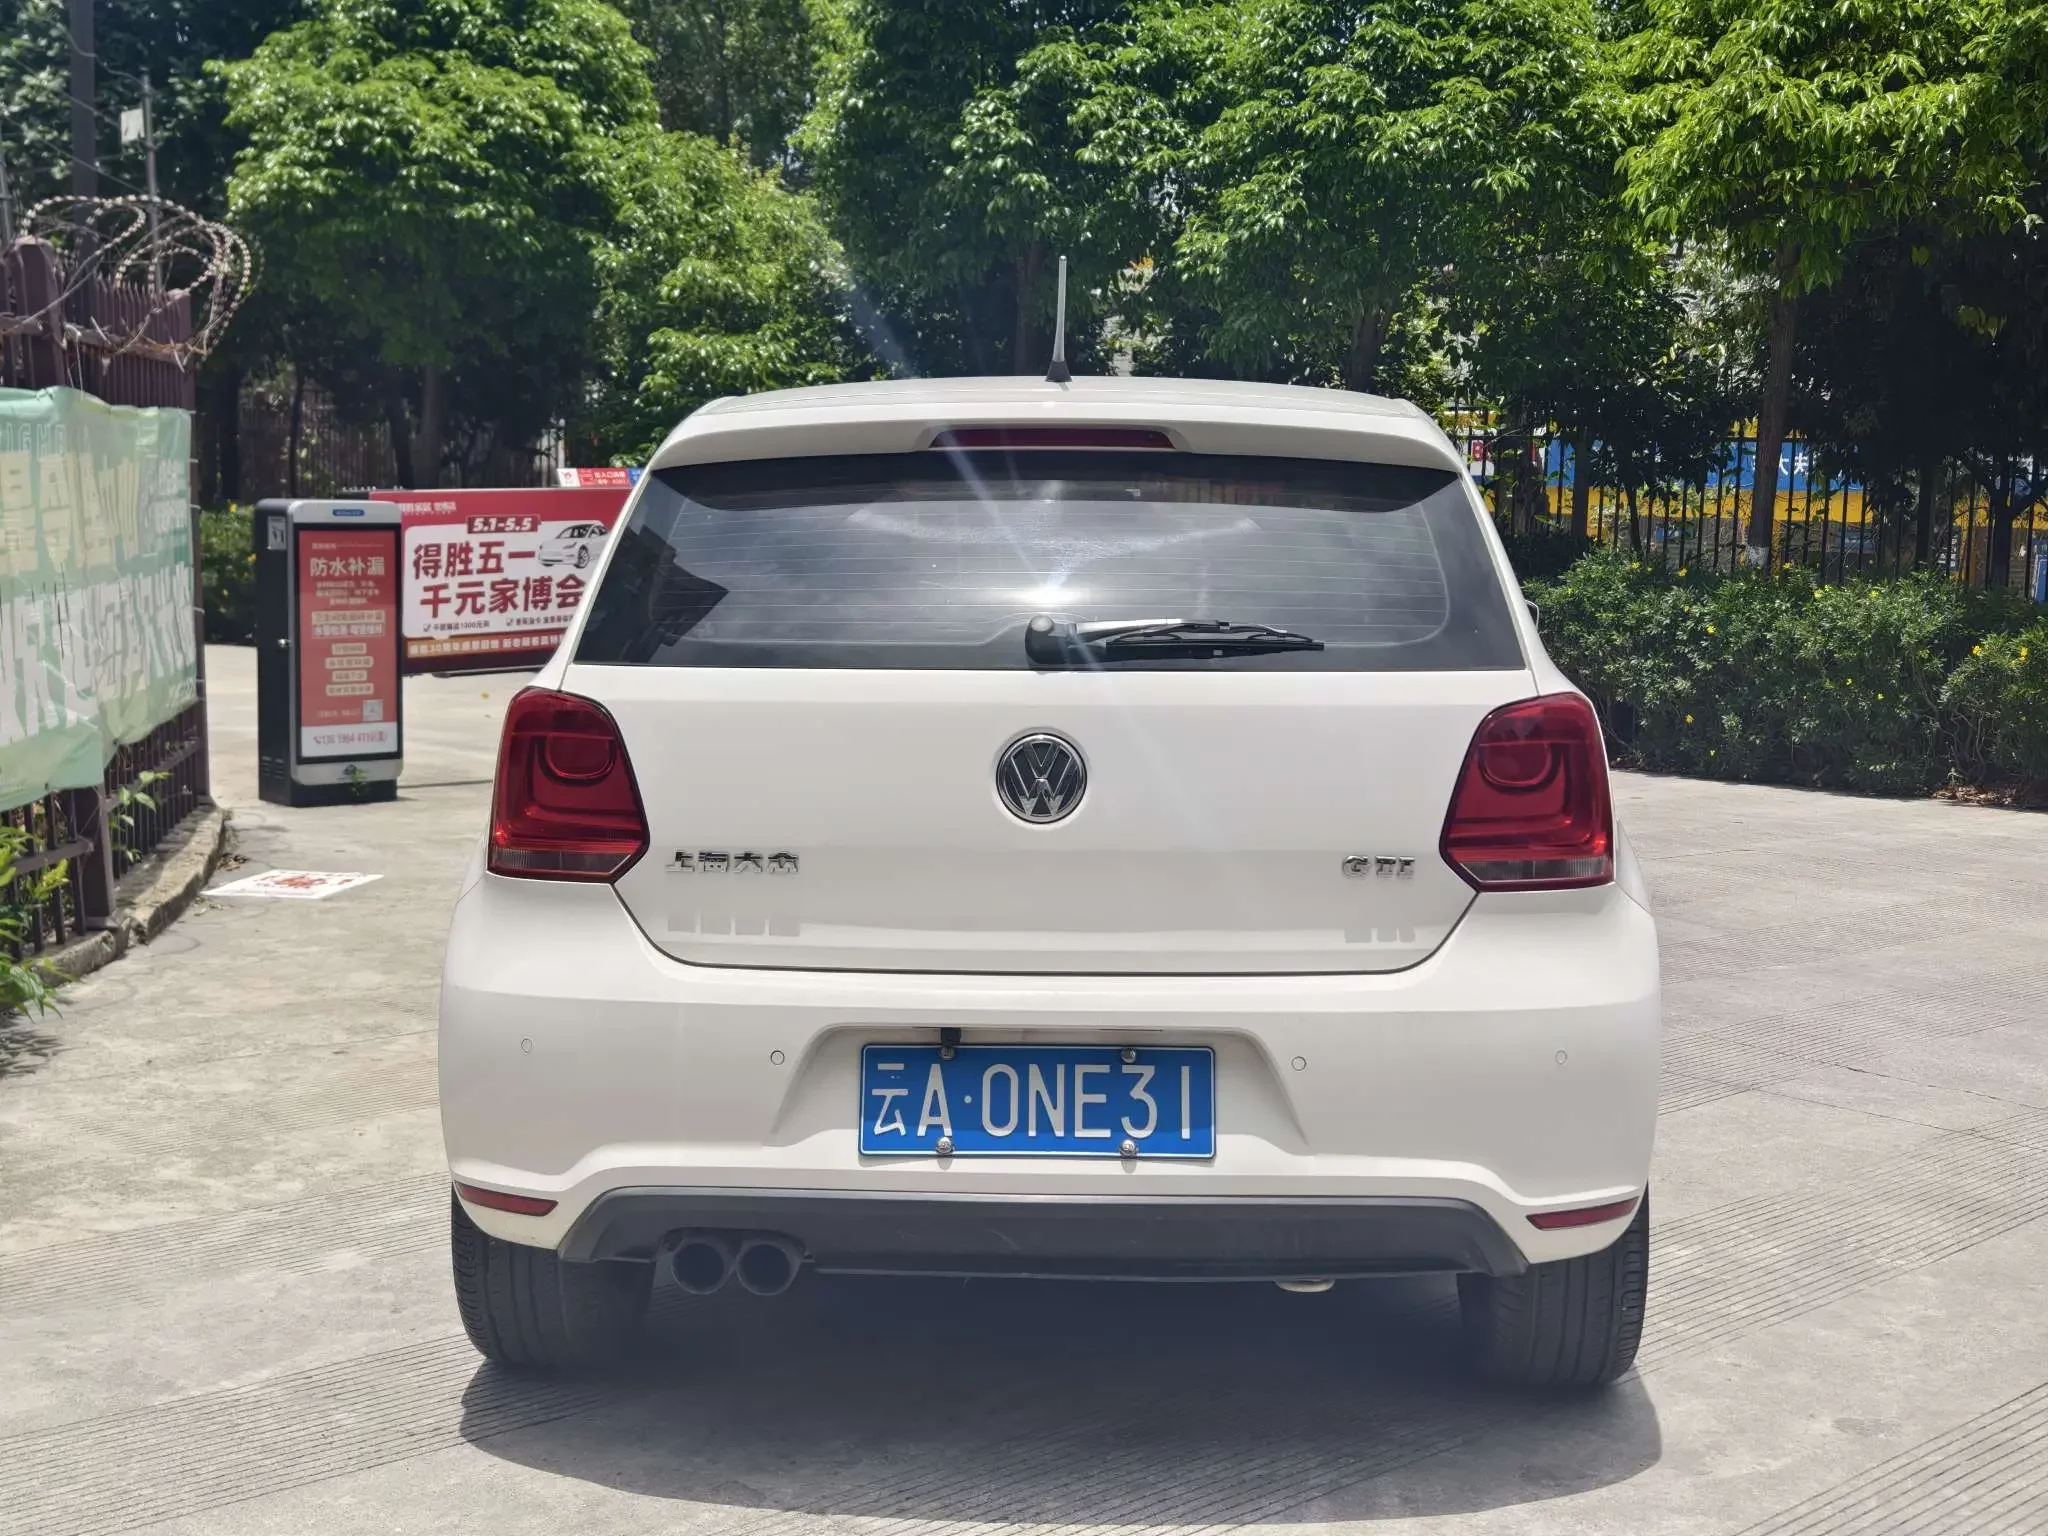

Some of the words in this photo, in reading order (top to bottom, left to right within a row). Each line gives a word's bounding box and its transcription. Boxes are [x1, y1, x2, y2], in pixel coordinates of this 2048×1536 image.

[472, 517, 533, 532] 5.1-5.5
[310, 556, 385, 577] 防水补漏
[413, 541, 536, 580] 得胜五一
[420, 574, 585, 619] 千元家博会
